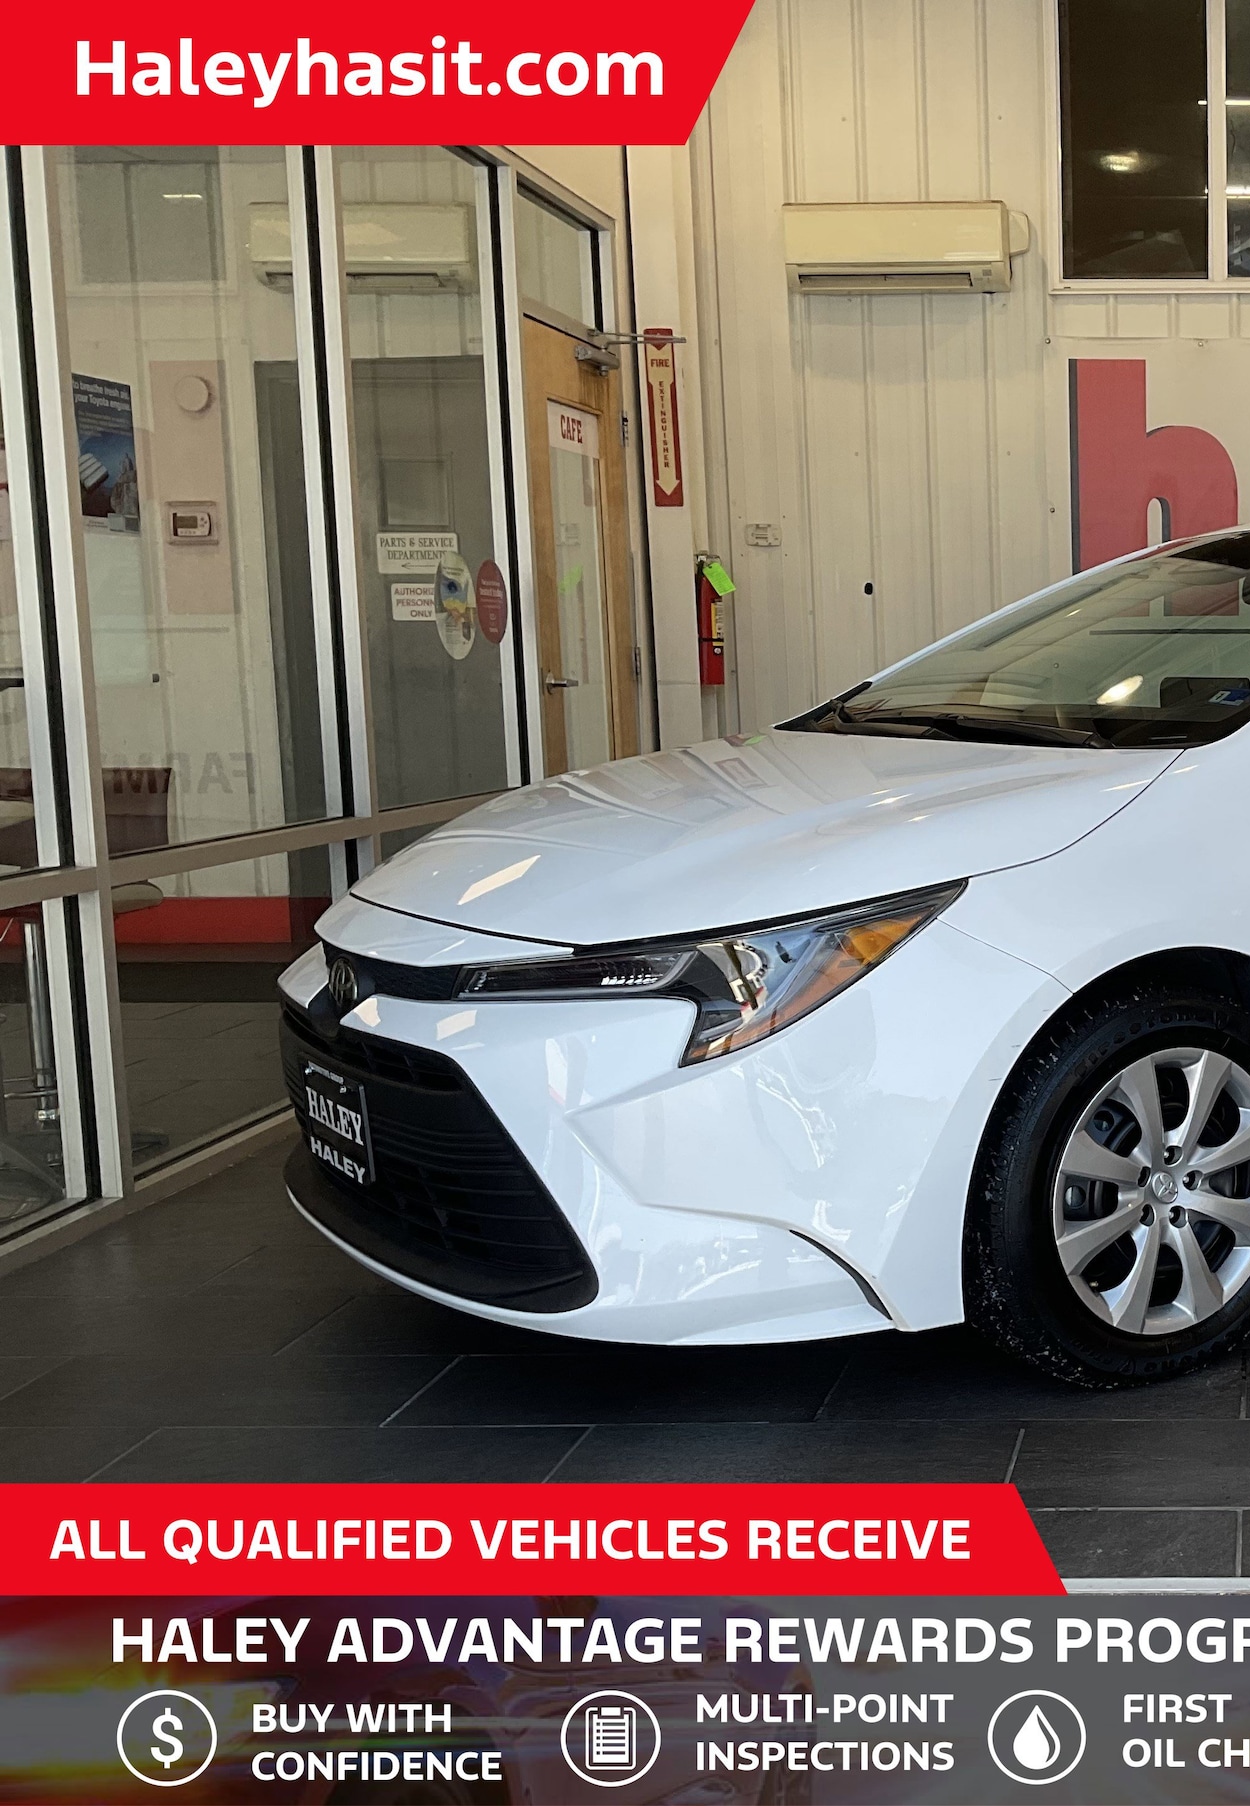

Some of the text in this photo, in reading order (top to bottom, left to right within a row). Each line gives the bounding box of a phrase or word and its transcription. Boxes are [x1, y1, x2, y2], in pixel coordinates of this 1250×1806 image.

[649, 358, 670, 368] FIRE
[89, 394, 109, 407] Toyota
[560, 413, 583, 444] CAFE
[658, 380, 670, 469] EXTINGUISHER
[380, 537, 454, 548] PARTS & SERVICE
[394, 587, 435, 596] AUTHORIZ
[396, 598, 435, 607] PERSONN
[410, 609, 433, 618] ONLY
[306, 1086, 364, 1146] HALEY
[310, 1136, 366, 1184] HALEY
